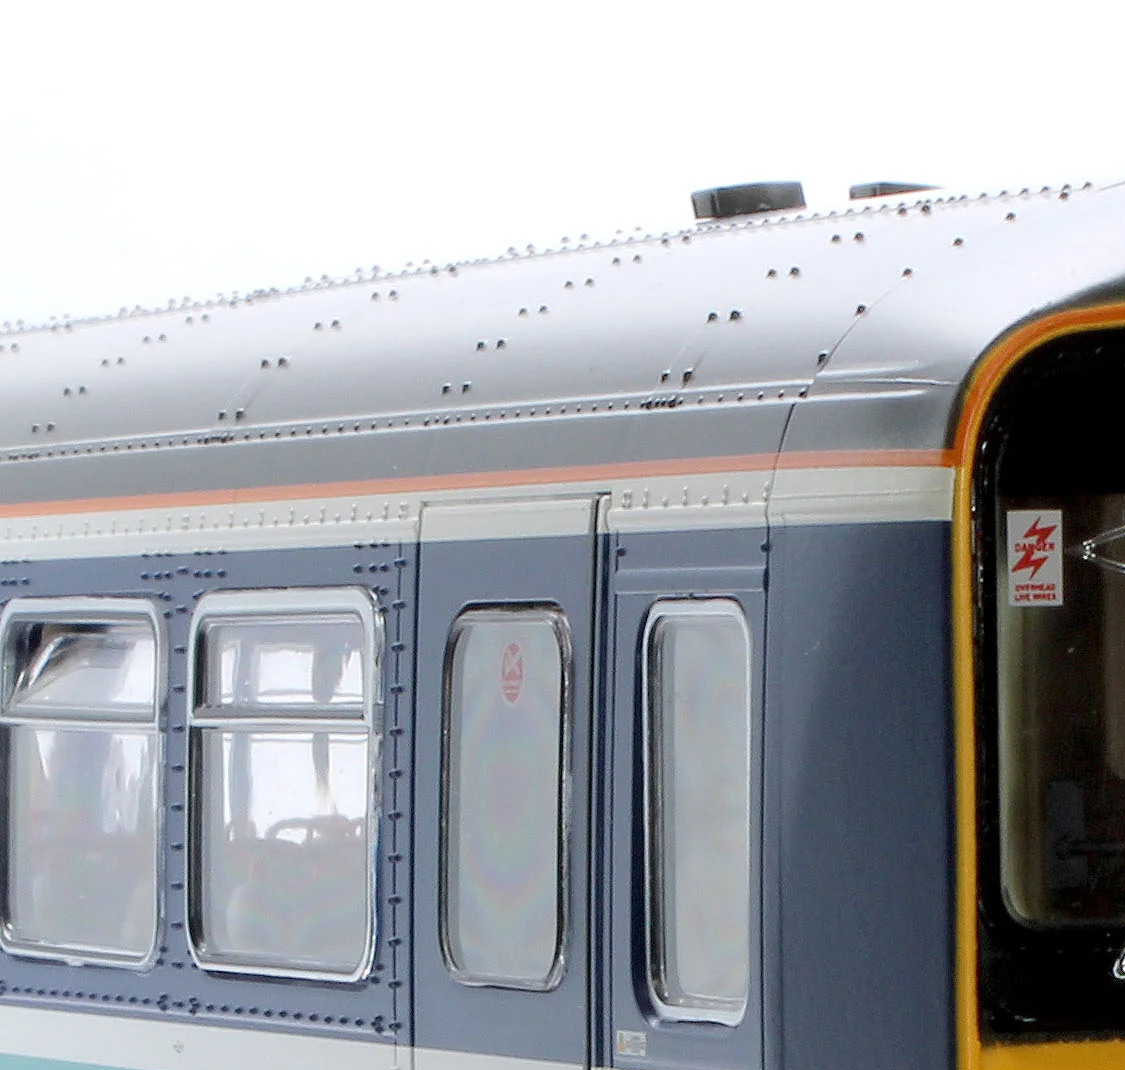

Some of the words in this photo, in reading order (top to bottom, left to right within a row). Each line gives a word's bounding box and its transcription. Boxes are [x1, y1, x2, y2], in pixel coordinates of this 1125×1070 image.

[1014, 542, 1055, 553] DANGER
[1015, 583, 1056, 592] OVERHEAD
[1014, 593, 1030, 601] LIVE
